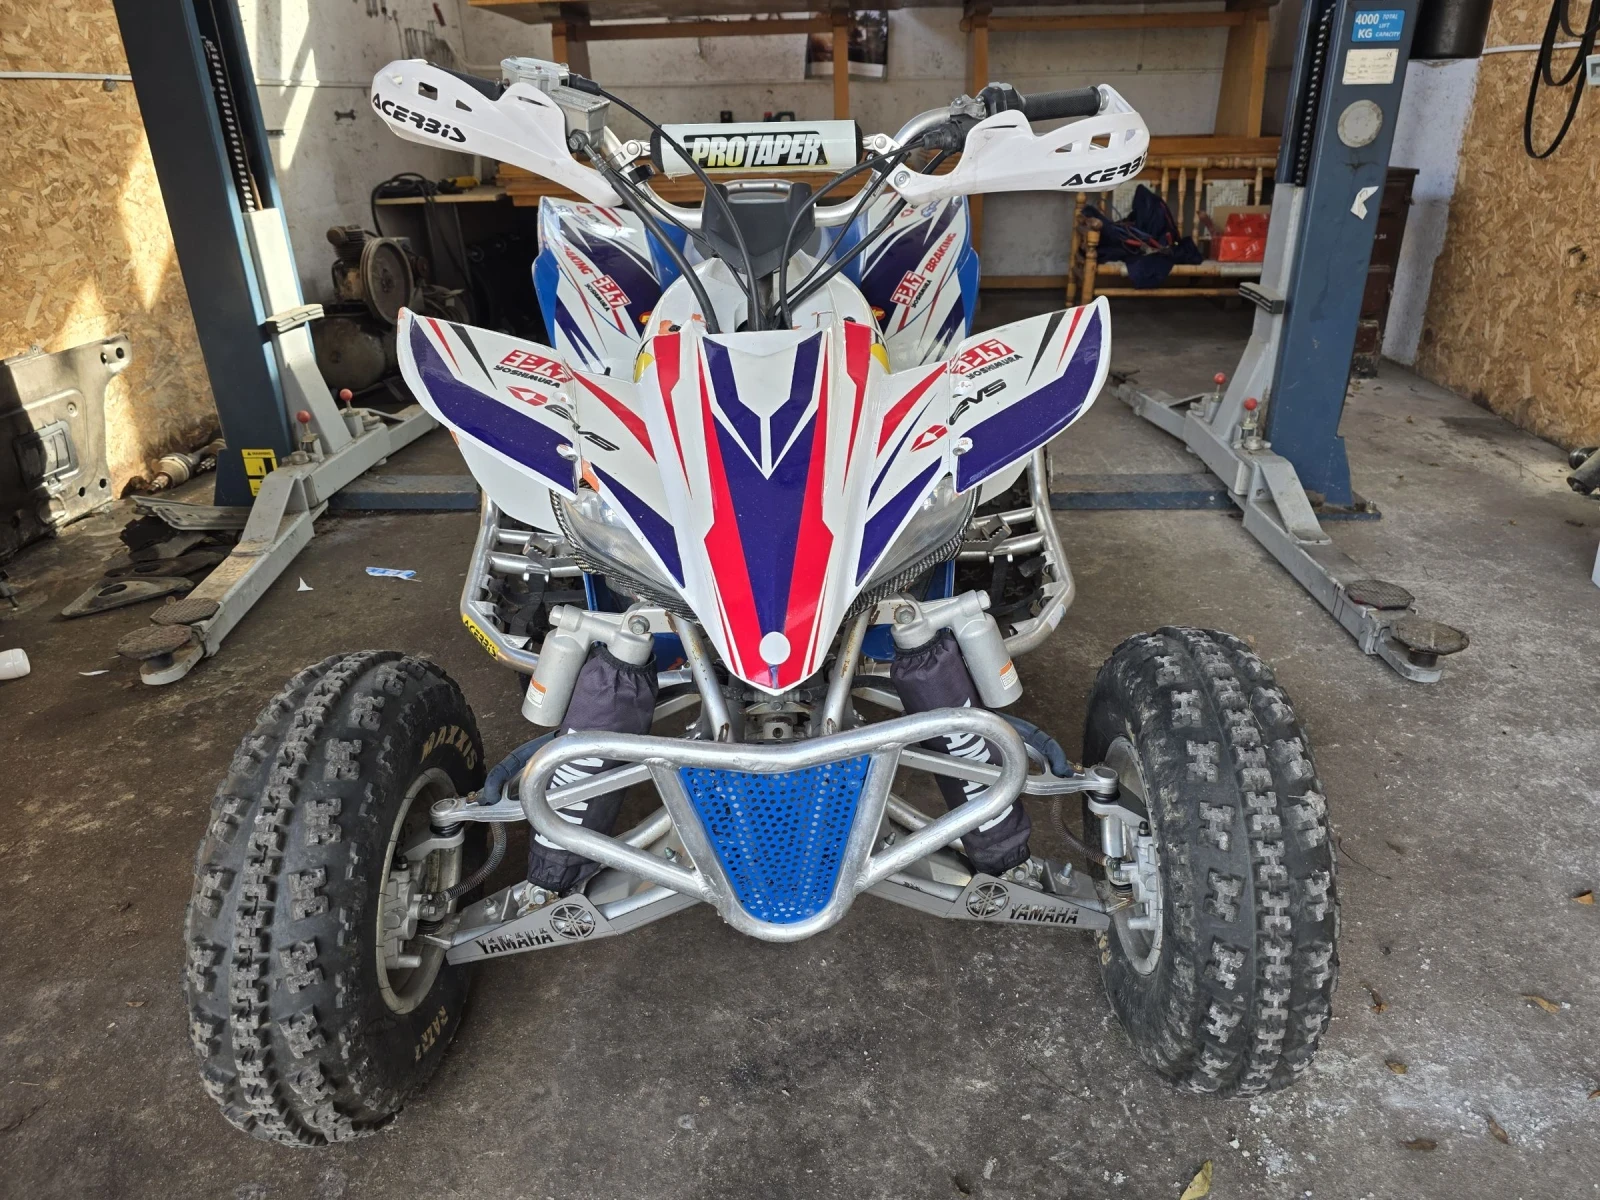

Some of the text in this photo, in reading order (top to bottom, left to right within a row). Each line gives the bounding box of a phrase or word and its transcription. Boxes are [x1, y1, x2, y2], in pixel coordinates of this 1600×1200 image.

[1355, 14, 1379, 25] 4000
[1357, 28, 1373, 39] KG
[691, 133, 822, 168] PROTAPER
[924, 233, 957, 273] BRAKING
[493, 364, 560, 388] YOSHIMURA
[965, 354, 1023, 379] YOSHIMURA
[419, 725, 478, 770] MAXXIS
[1009, 903, 1080, 925] YAMAHA
[475, 928, 554, 955] YAMAHA
